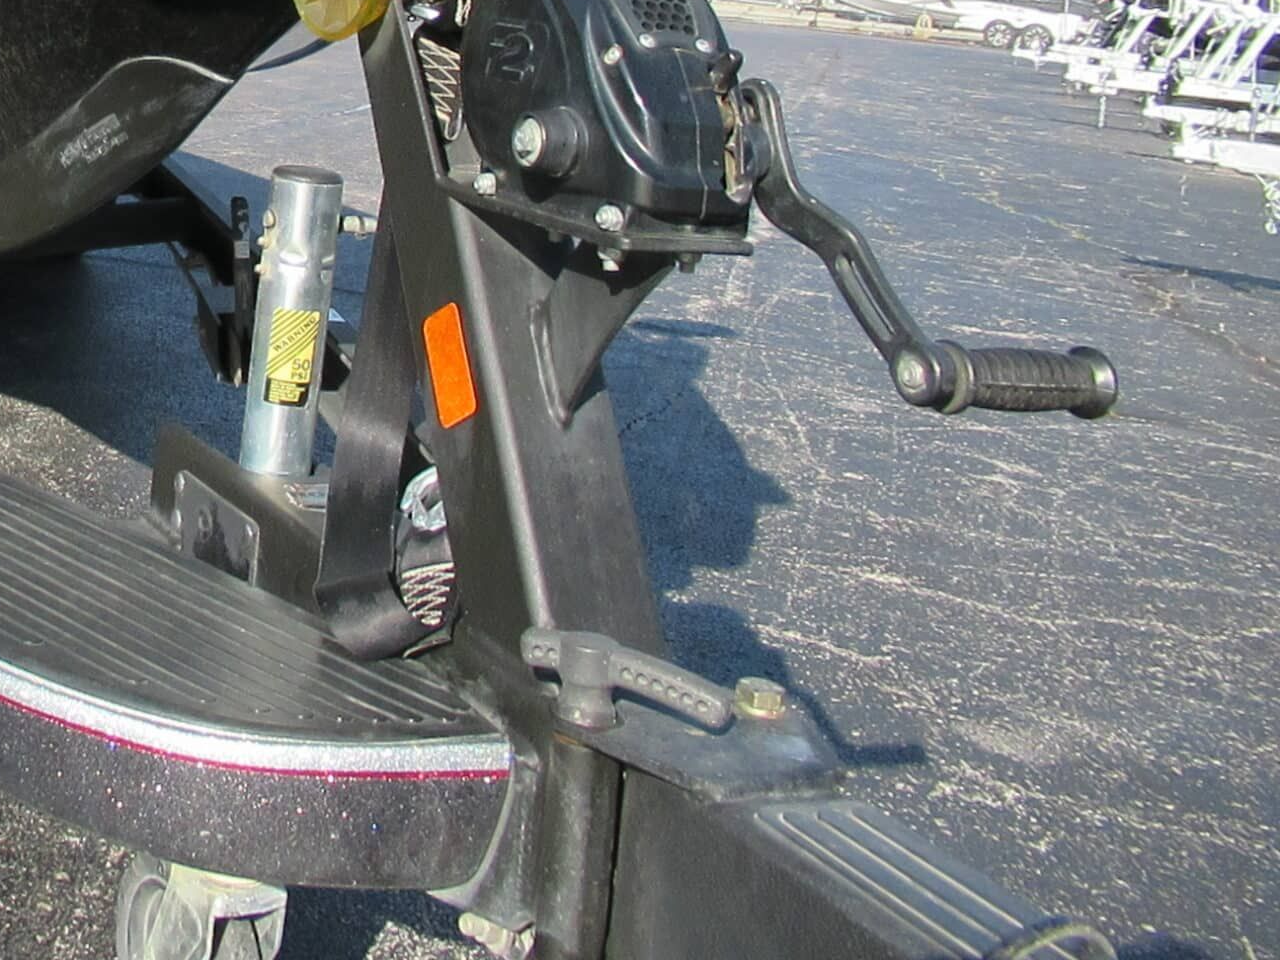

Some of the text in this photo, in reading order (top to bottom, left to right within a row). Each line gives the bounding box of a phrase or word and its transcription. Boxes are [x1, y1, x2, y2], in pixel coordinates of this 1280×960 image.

[273, 316, 316, 353] WARNING
[291, 358, 311, 371] 50
[290, 371, 308, 381] PSI
